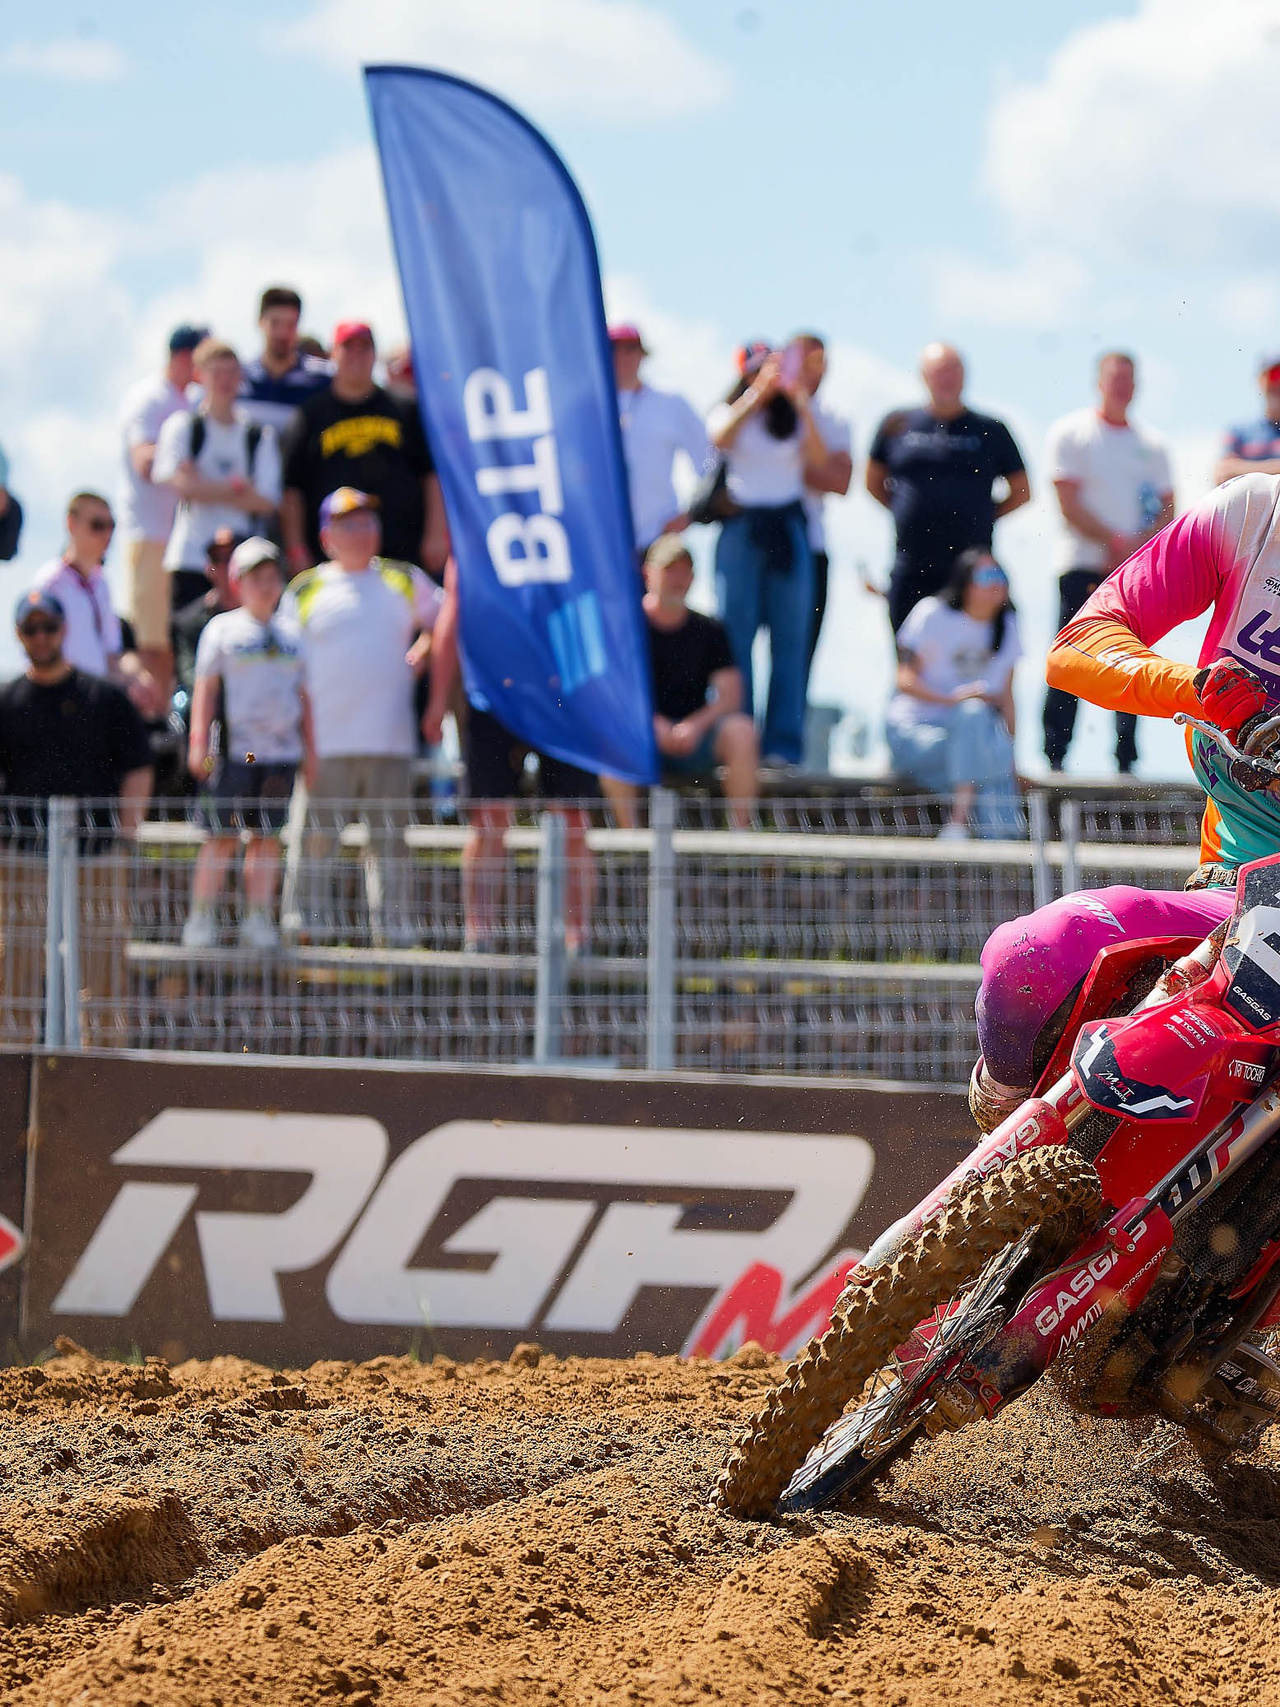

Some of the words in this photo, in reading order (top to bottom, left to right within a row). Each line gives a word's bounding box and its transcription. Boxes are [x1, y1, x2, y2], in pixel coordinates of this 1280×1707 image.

[1232, 985, 1272, 1021] GASGAS
[52, 1106, 875, 1333] RGP
[1107, 1245, 1167, 1305] OTORSPORTS
